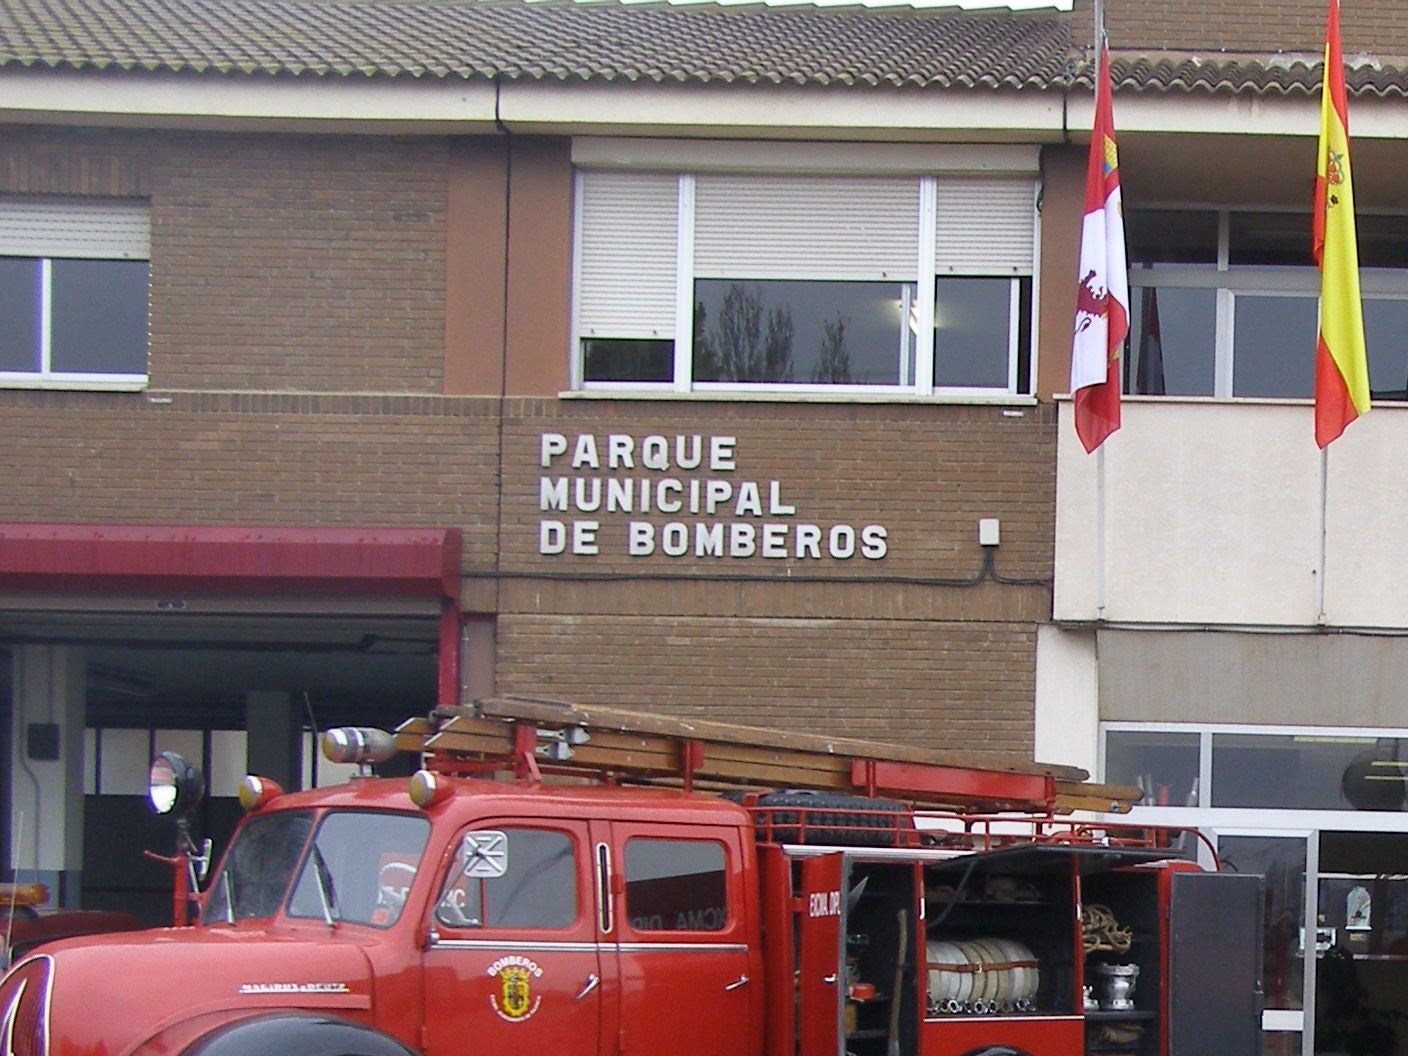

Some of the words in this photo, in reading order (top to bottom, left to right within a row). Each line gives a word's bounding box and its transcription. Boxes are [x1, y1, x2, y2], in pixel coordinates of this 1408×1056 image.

[540, 433, 738, 472] PARQUE
[539, 476, 797, 517] MUNICIPAL
[539, 520, 600, 556] DE
[628, 520, 889, 560] BOMBEROS
[487, 955, 543, 977] BOMBEROS
